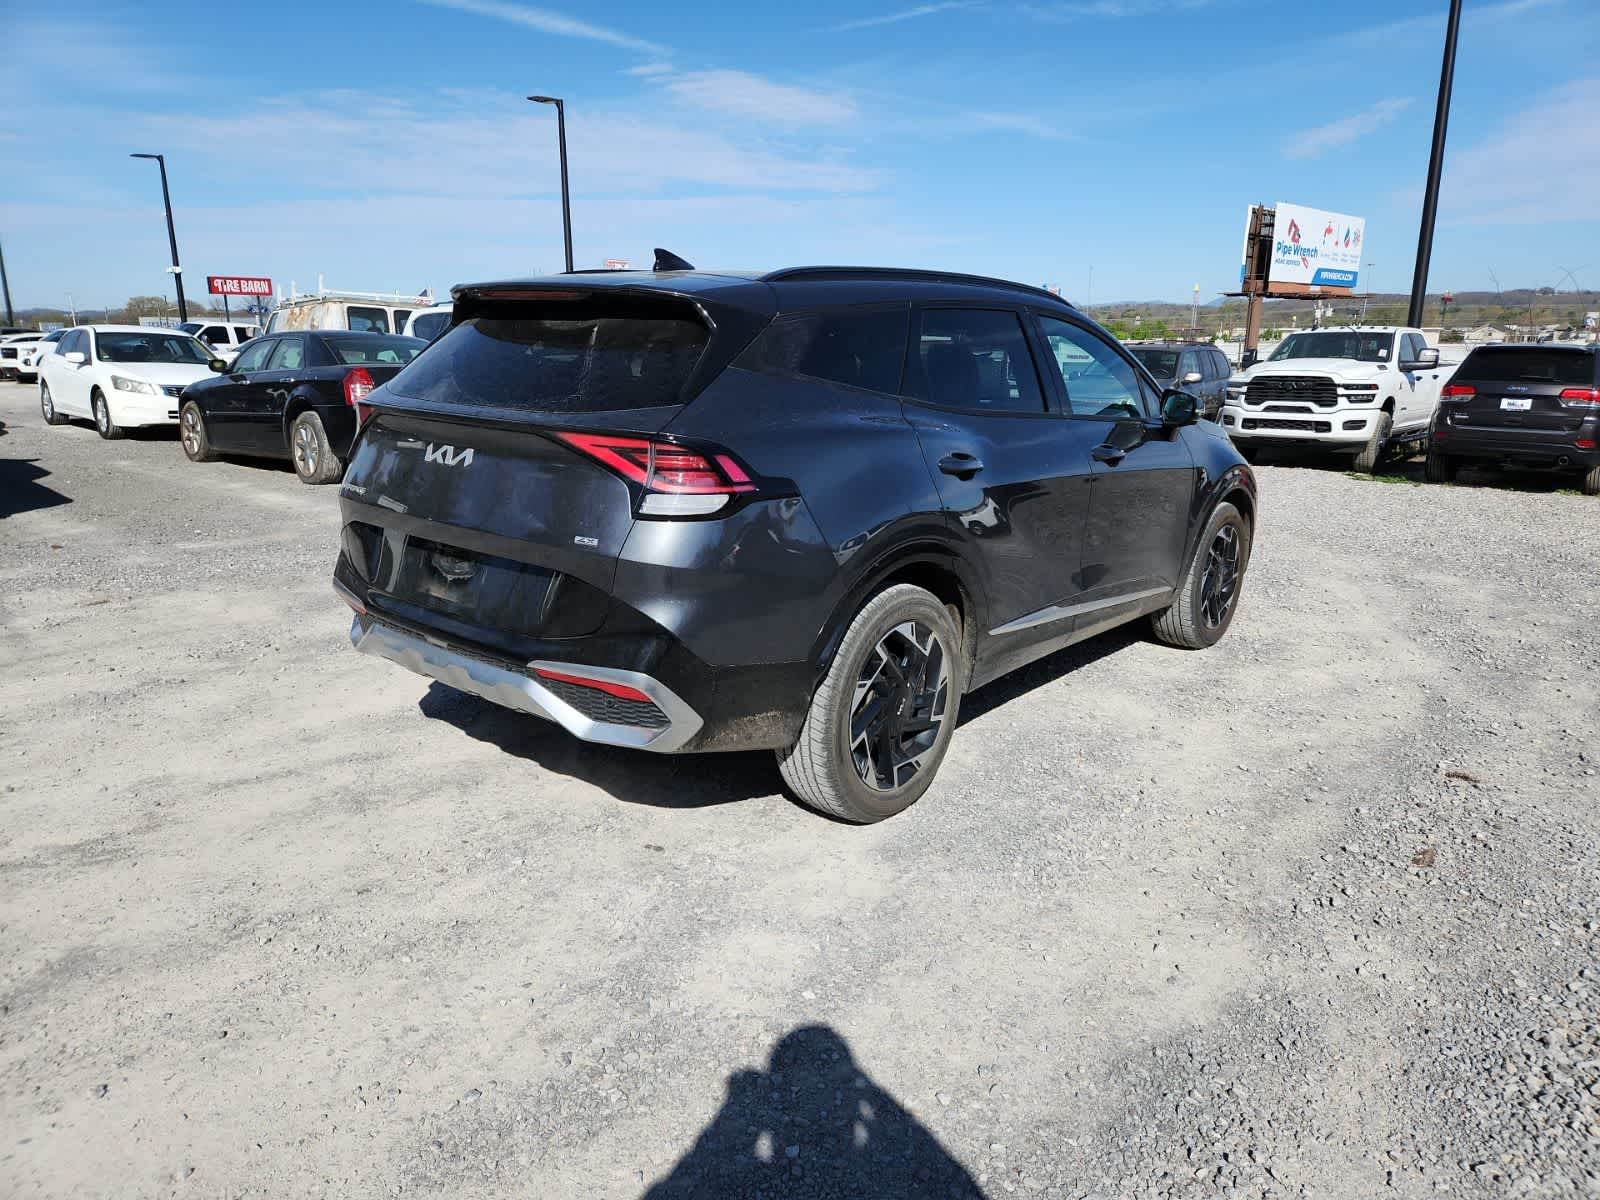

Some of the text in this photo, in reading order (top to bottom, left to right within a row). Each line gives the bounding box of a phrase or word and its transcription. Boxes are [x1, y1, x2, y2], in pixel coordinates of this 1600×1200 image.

[1277, 241, 1292, 257] Pipe
[1293, 244, 1318, 258] Wrench
[241, 280, 269, 293] BARN
[424, 441, 474, 467] KIA
